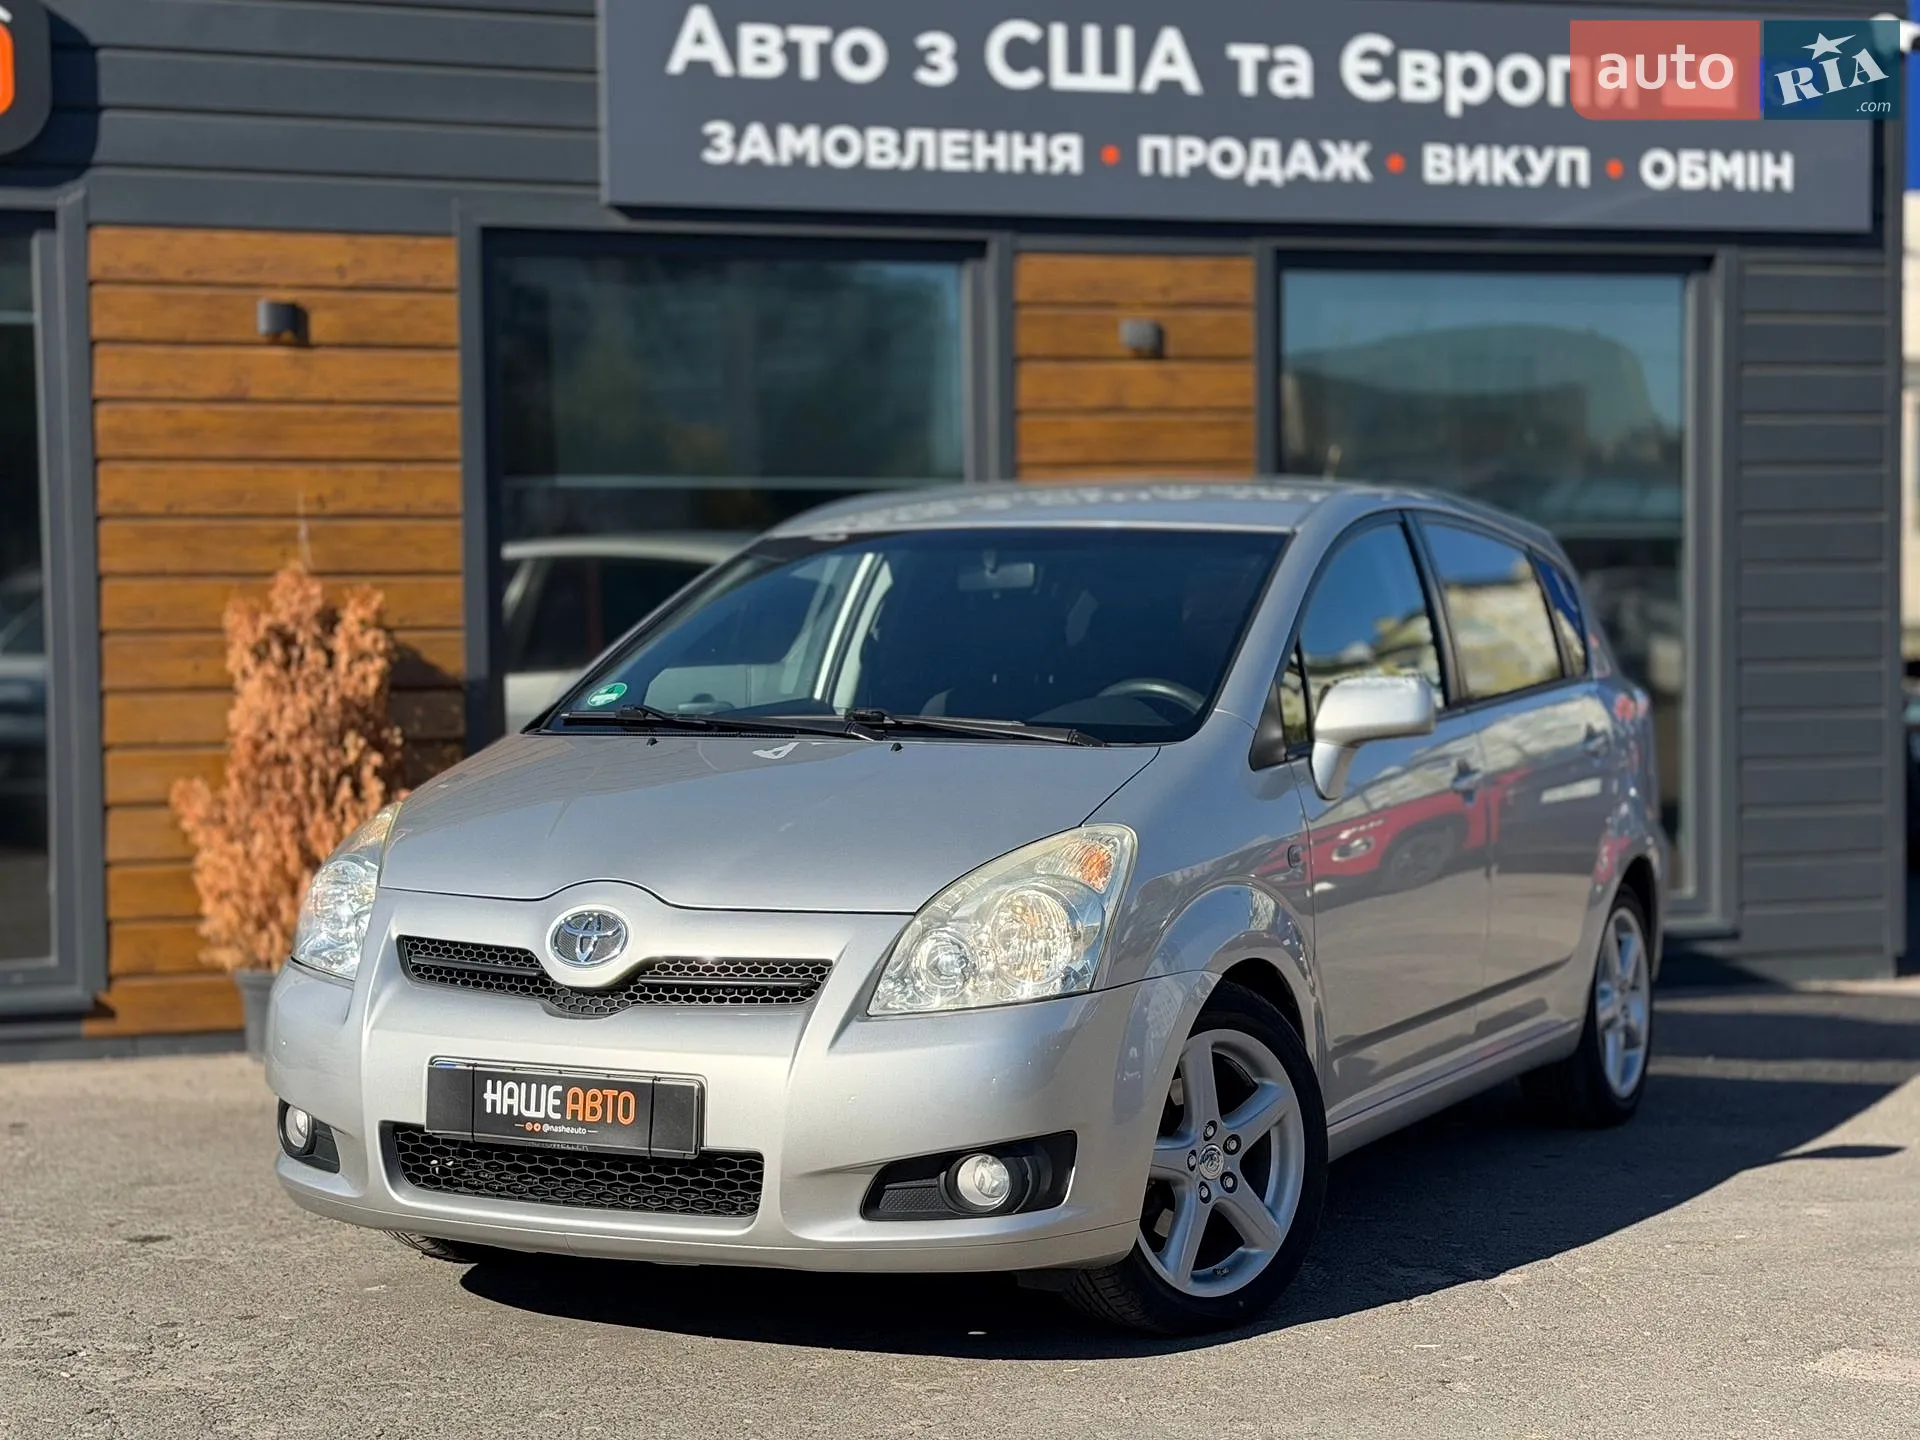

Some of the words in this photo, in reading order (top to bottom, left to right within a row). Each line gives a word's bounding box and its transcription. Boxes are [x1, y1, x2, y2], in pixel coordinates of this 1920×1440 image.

[665, 3, 889, 85] Авто
[913, 30, 959, 87] з
[984, 18, 1203, 96] США
[1226, 42, 1315, 99] та
[701, 120, 1085, 175] ЗАМОВЛЕННЯ
[1137, 134, 1374, 188] ПРОДАЖ
[1421, 143, 1592, 188] ВИКУП
[1638, 147, 1796, 192] ОБМІН
[483, 1079, 563, 1120] НАШЕ
[566, 1086, 637, 1126] АВТО
[542, 1123, 587, 1135] @nasheauto
